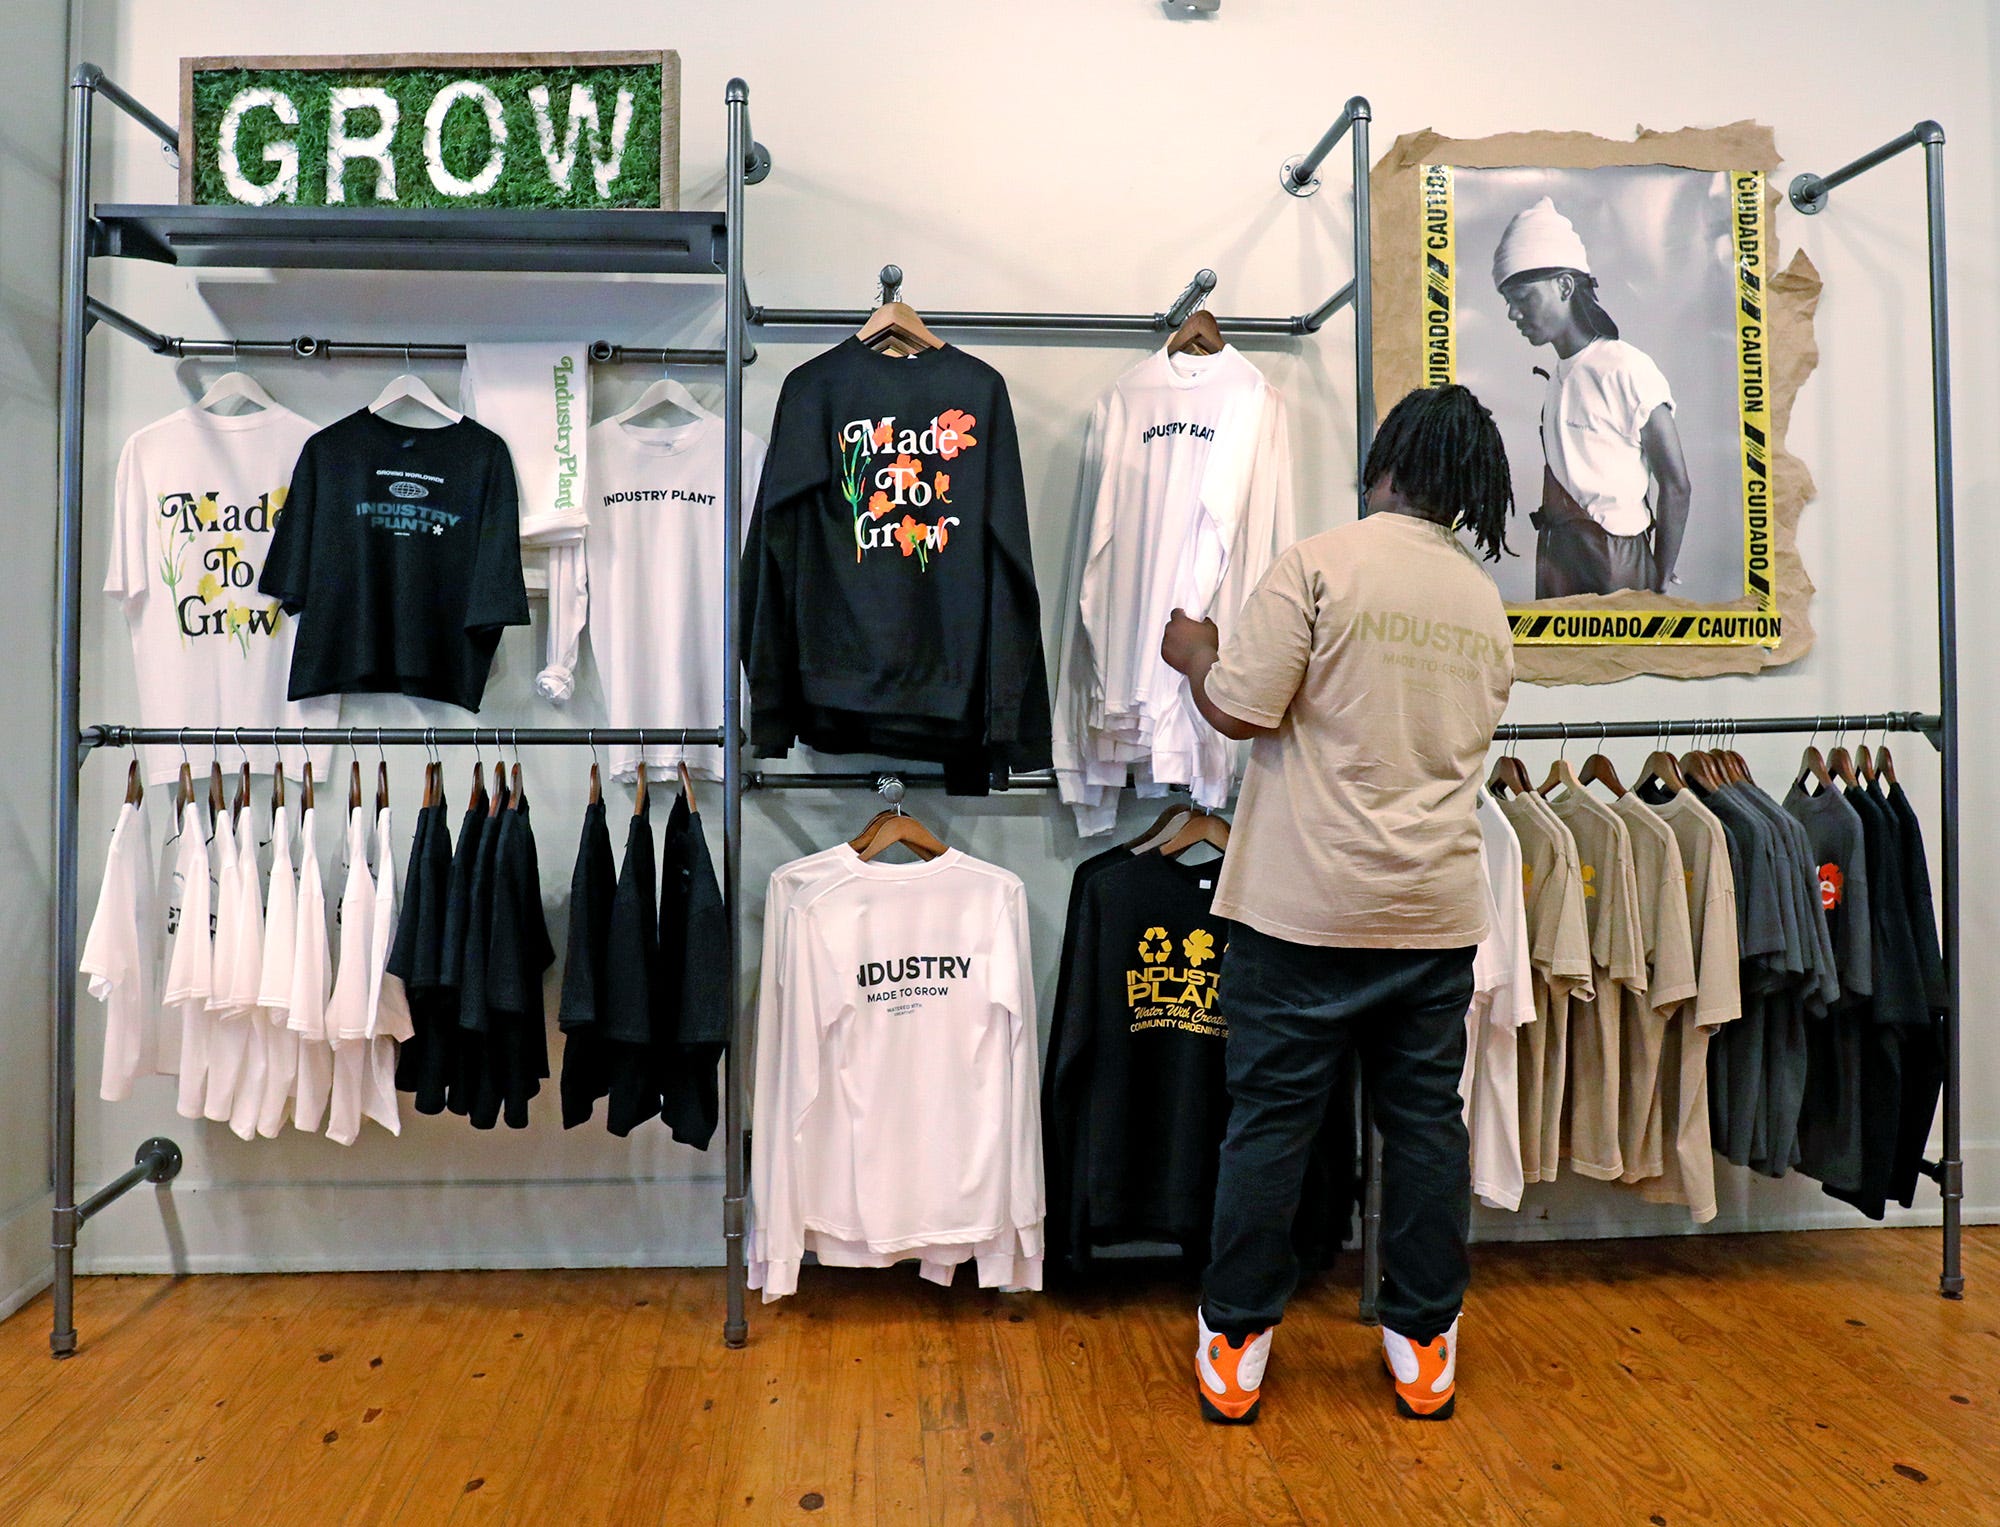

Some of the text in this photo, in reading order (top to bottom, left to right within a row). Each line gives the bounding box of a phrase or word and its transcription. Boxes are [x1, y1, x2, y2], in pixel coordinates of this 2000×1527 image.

[217, 79, 633, 208] GROW
[1428, 310, 1450, 387] UIDADO
[1737, 177, 1768, 570] CUIDADO CAUTION CUIDADO
[843, 416, 959, 457] Made
[603, 490, 716, 507] INDUSTRY PLANT
[875, 467, 932, 507] To
[356, 502, 461, 527] INDUSTRY
[204, 547, 254, 588] To
[1349, 611, 1507, 666] INDUSTRY
[1553, 616, 1781, 638] CUIDADO CAUTION
[1126, 967, 1221, 989] INDUST
[867, 987, 949, 1003] MADE TO GROW
[1128, 982, 1219, 1009] PLAN
[1134, 1006, 1164, 1019] Water
[1166, 1004, 1190, 1018] With
[1130, 1018, 1177, 1032] COMMUNITY
[1178, 1020, 1220, 1037] GARDENING
